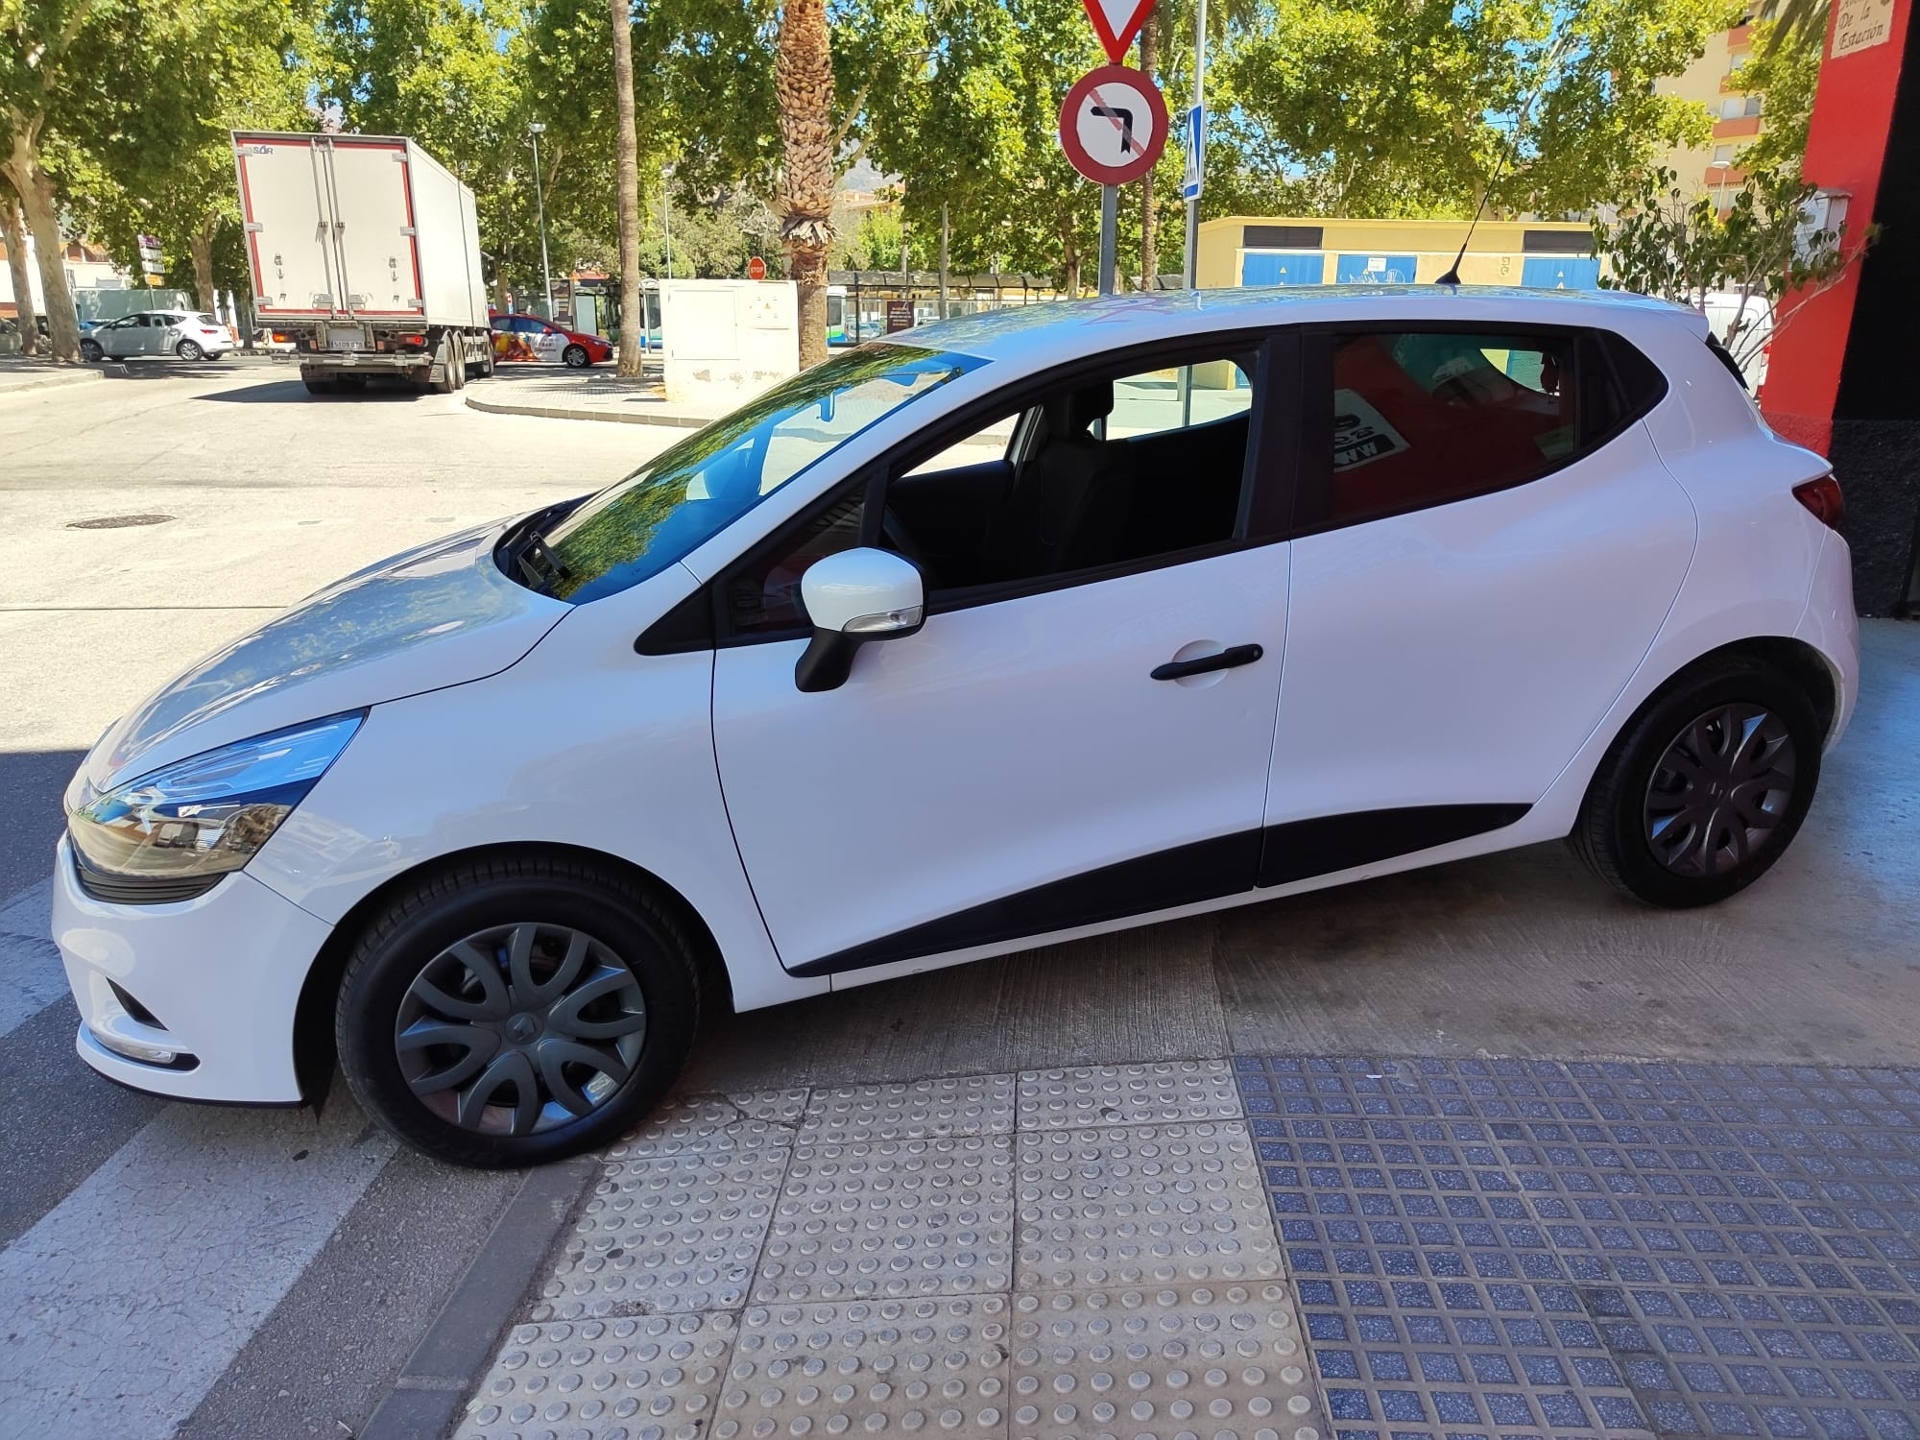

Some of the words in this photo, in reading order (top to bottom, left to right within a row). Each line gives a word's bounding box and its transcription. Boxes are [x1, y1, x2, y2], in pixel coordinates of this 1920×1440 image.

[1839, 13, 1854, 30] De
[1860, 1, 1871, 21] la
[1839, 20, 1884, 50] Estación
